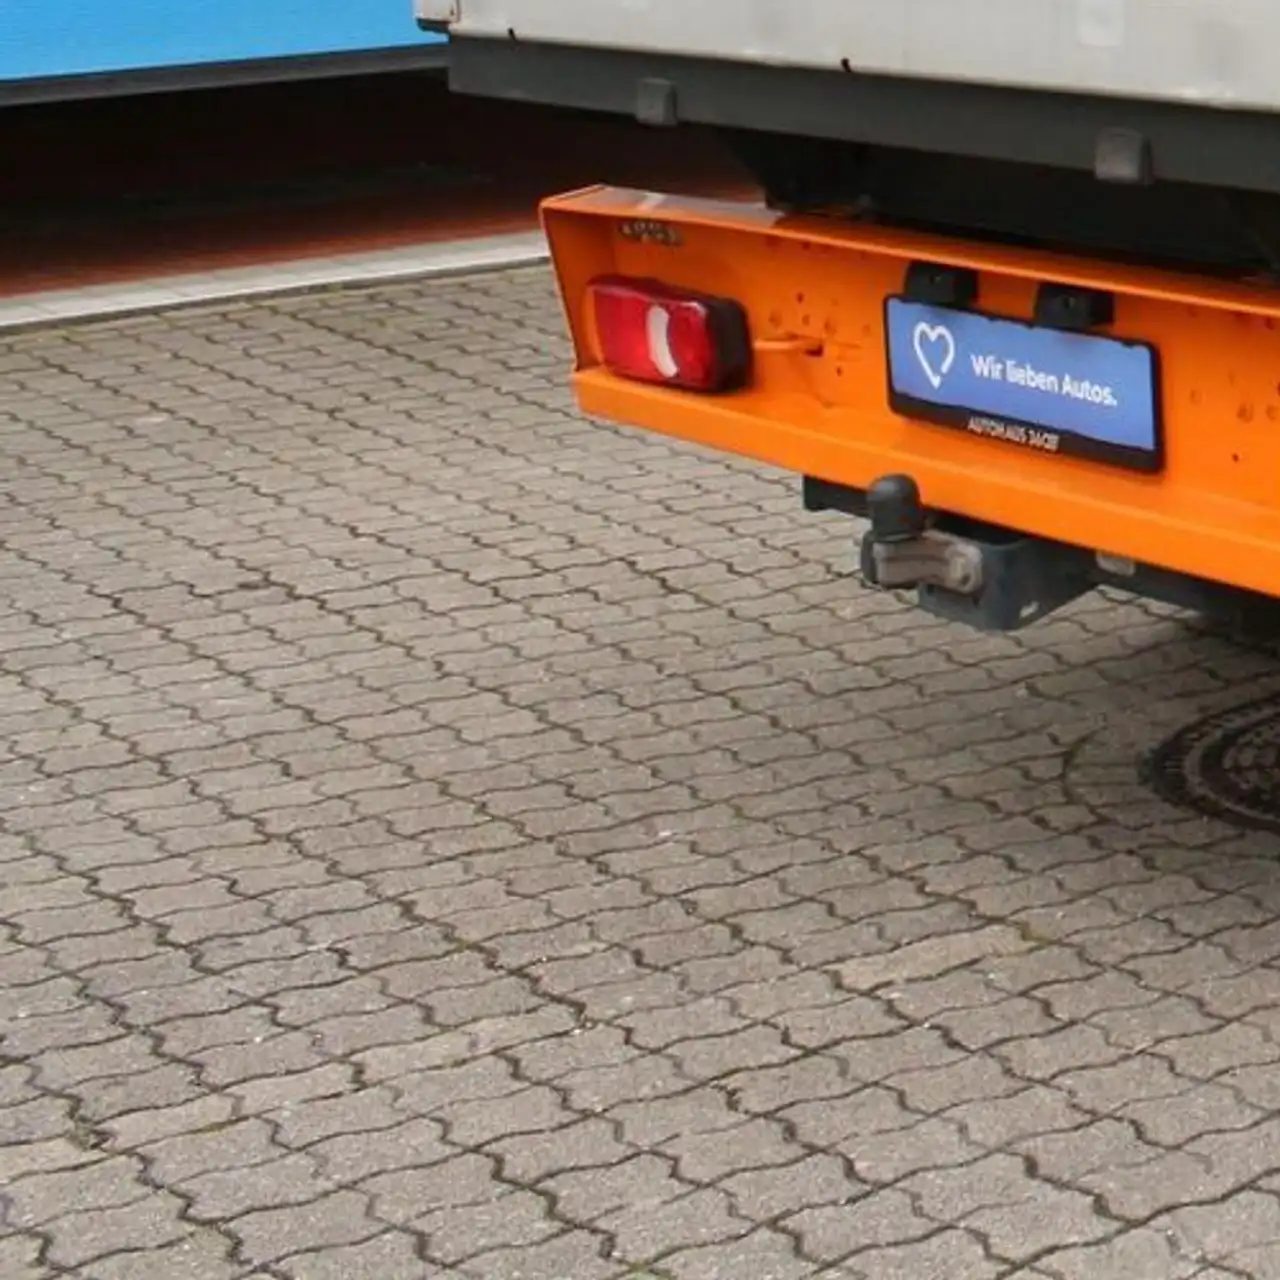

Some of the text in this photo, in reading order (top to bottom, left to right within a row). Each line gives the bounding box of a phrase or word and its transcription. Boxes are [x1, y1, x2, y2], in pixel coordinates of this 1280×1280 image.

[969, 353, 1117, 407] Wir lieben Autos.
